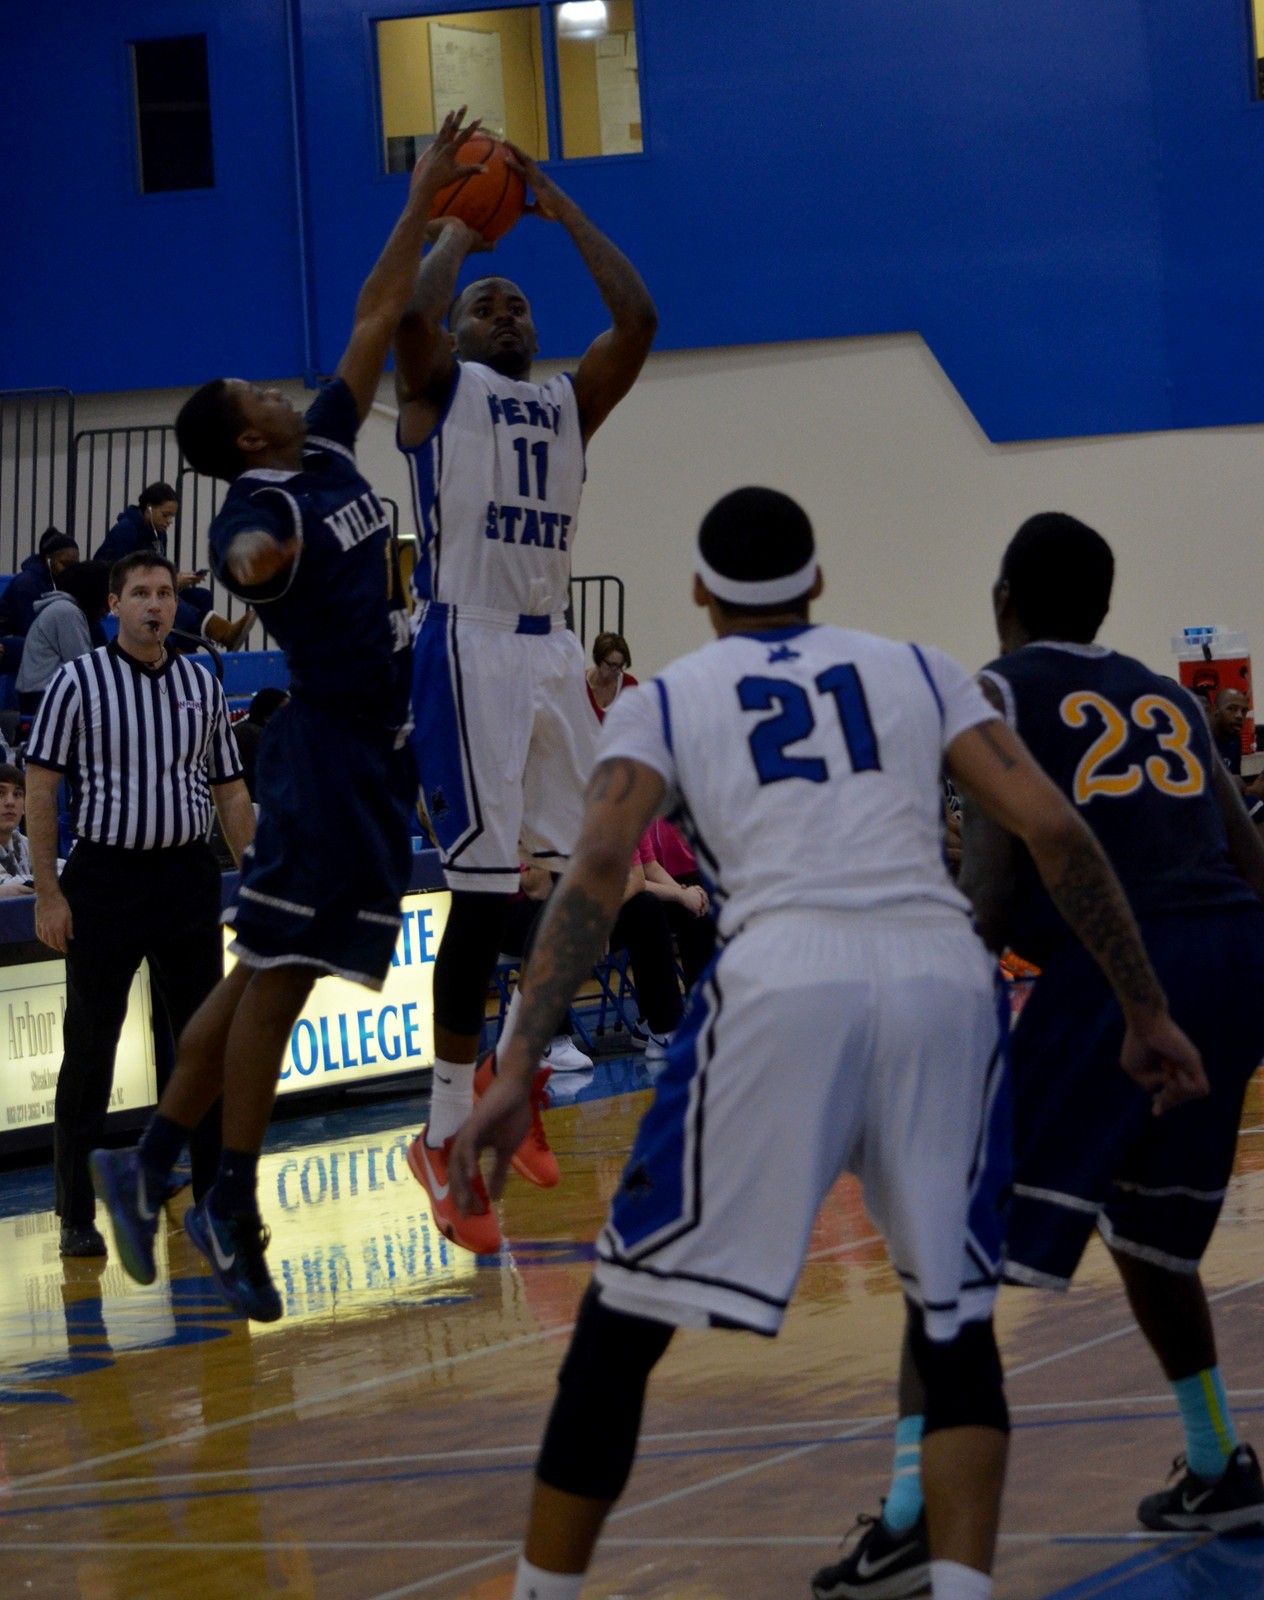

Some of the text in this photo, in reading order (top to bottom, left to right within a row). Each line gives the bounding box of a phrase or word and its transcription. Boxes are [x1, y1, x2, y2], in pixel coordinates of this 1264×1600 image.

[513, 437, 548, 500] 11
[486, 501, 571, 551] STATE
[736, 663, 882, 786] 21
[1058, 690, 1205, 806] 23
[8, 1001, 56, 1060] Arbor
[279, 1003, 421, 1079] OLLEGE
